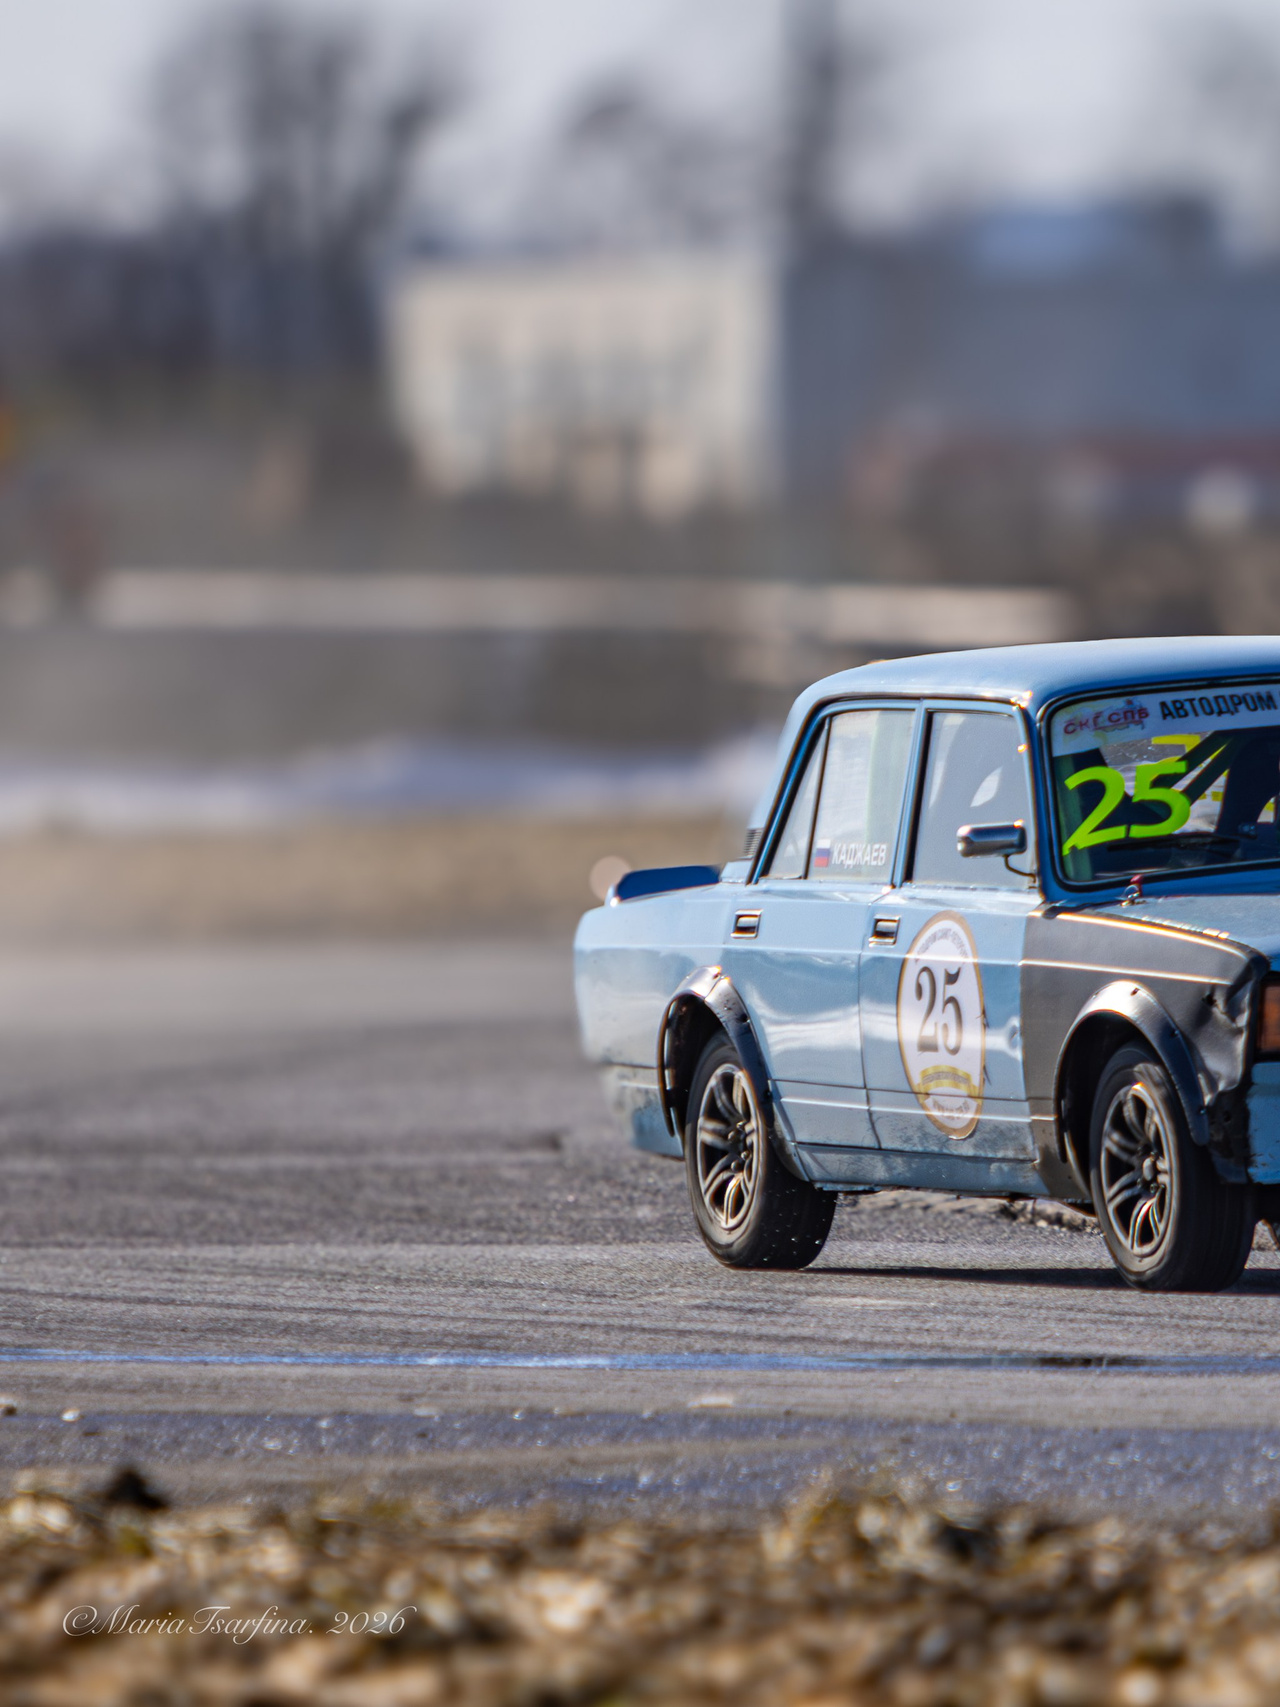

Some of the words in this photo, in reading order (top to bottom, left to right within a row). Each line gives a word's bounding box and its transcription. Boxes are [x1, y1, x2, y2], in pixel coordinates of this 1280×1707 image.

[1107, 707, 1149, 724] СПБ
[1160, 690, 1278, 721] АВТОДРОМ
[1062, 760, 1191, 857] 25
[831, 842, 887, 869] КАДЖАЕВ
[915, 966, 963, 1056] 25
